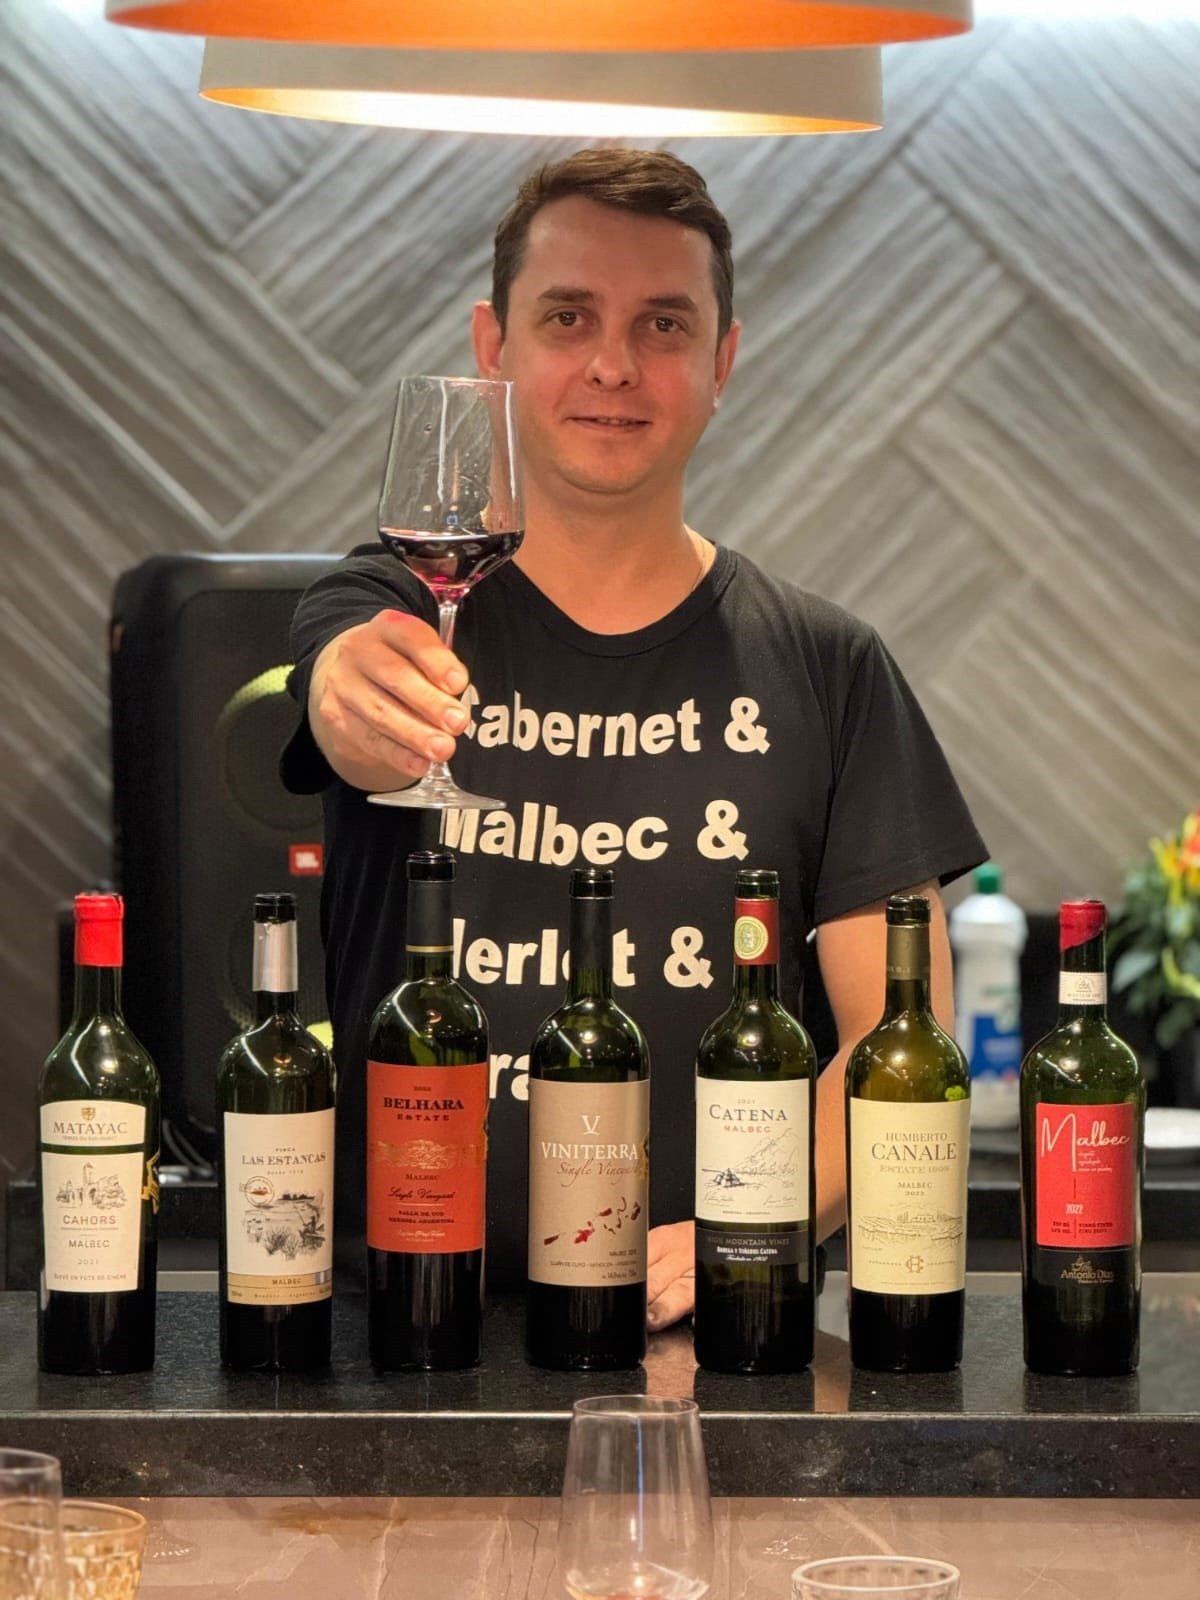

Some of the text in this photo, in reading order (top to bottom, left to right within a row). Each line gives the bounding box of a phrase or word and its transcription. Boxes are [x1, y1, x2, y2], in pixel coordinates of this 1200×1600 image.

[724, 697, 770, 754] &
[439, 800, 750, 867] Malbec &
[453, 918, 714, 988] erlt &
[383, 1097, 464, 1110] BELHARA
[397, 1113, 450, 1121] ESTATE
[709, 1104, 788, 1121] CATENA
[53, 1121, 128, 1134] MATAYAC
[724, 1125, 771, 1133] MALBEC
[886, 1132, 948, 1142] HUMBERTO
[1041, 1112, 1130, 1172] Malbec
[541, 1141, 639, 1160] VINITERRA
[871, 1143, 957, 1160] CANALE
[242, 1155, 264, 1166] LAS
[63, 1215, 117, 1225] CAHORS
[69, 1240, 111, 1248] MALBEC
[725, 1238, 767, 1246] MOUNTAIN
[1061, 1270, 1096, 1279] Antonio
